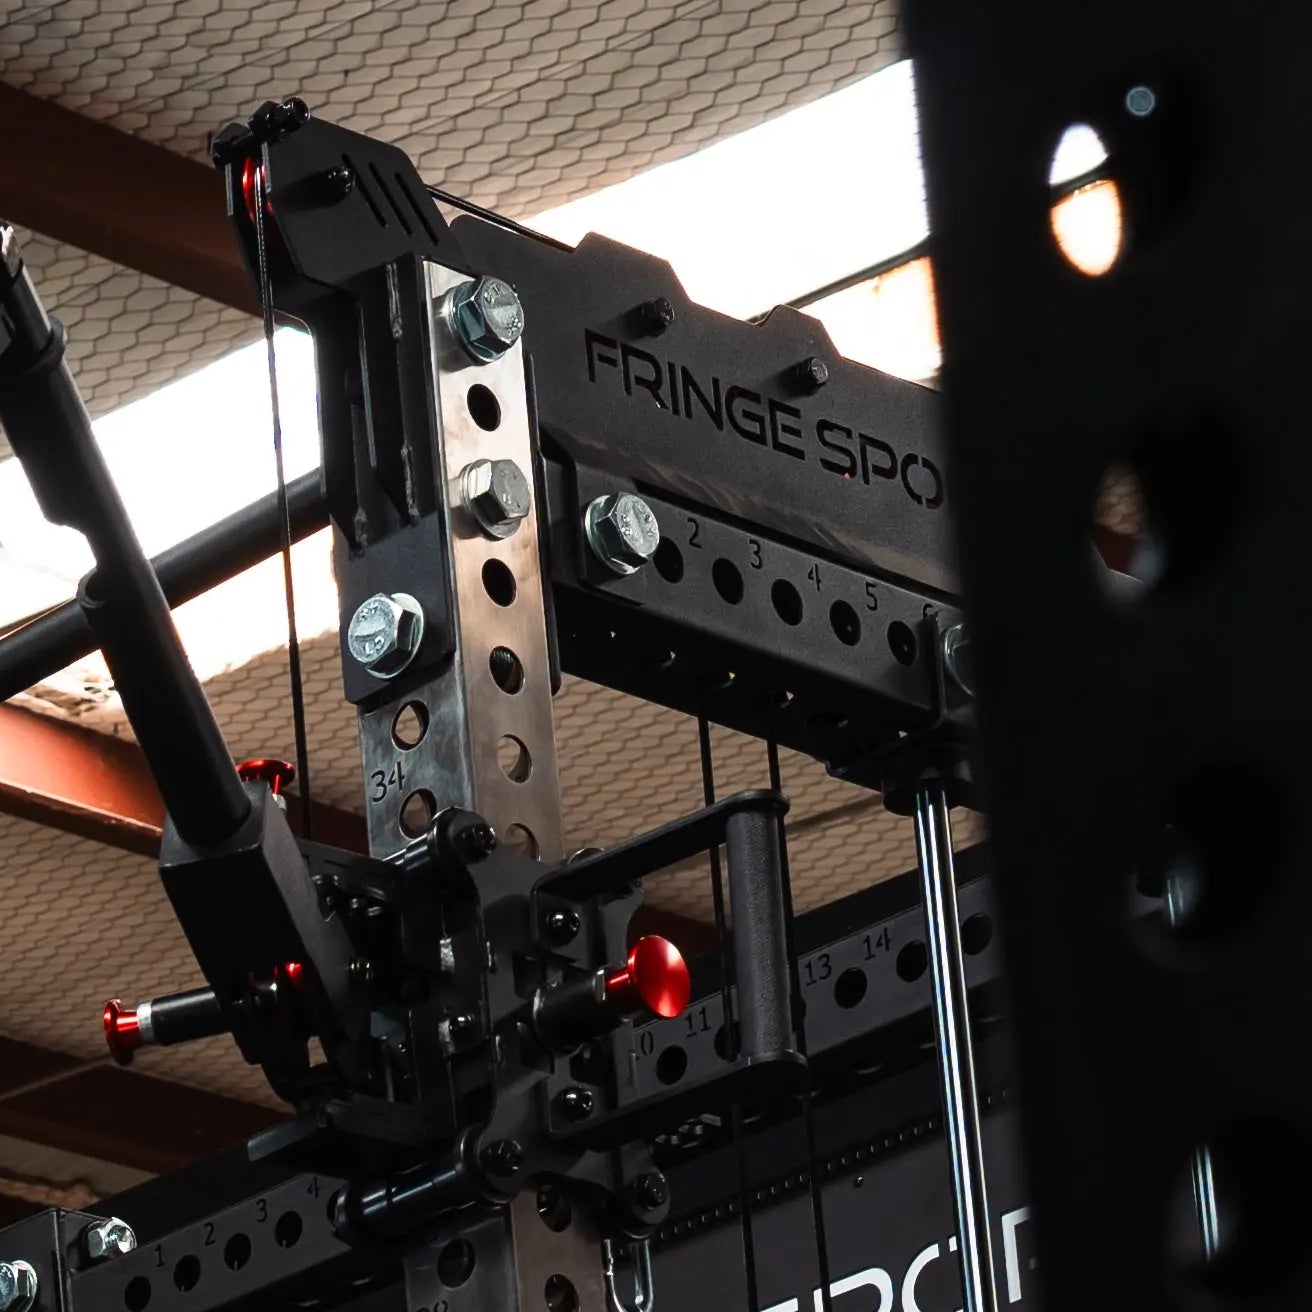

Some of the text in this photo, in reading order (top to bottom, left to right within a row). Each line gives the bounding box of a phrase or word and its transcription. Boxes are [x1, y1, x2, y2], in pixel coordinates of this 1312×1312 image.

[584, 329, 805, 460] FRINGE
[688, 518, 702, 547] 2
[749, 541, 763, 569] 3
[808, 564, 822, 592] 4
[864, 582, 878, 612] 5
[371, 761, 405, 803] 34
[863, 927, 892, 962] 14
[803, 954, 833, 986] 13
[684, 1008, 712, 1039] 11
[637, 1029, 655, 1060] 0
[307, 1175, 321, 1199] 4
[256, 1199, 268, 1222] 3
[203, 1222, 216, 1246] 2
[155, 1247, 165, 1268] 1
